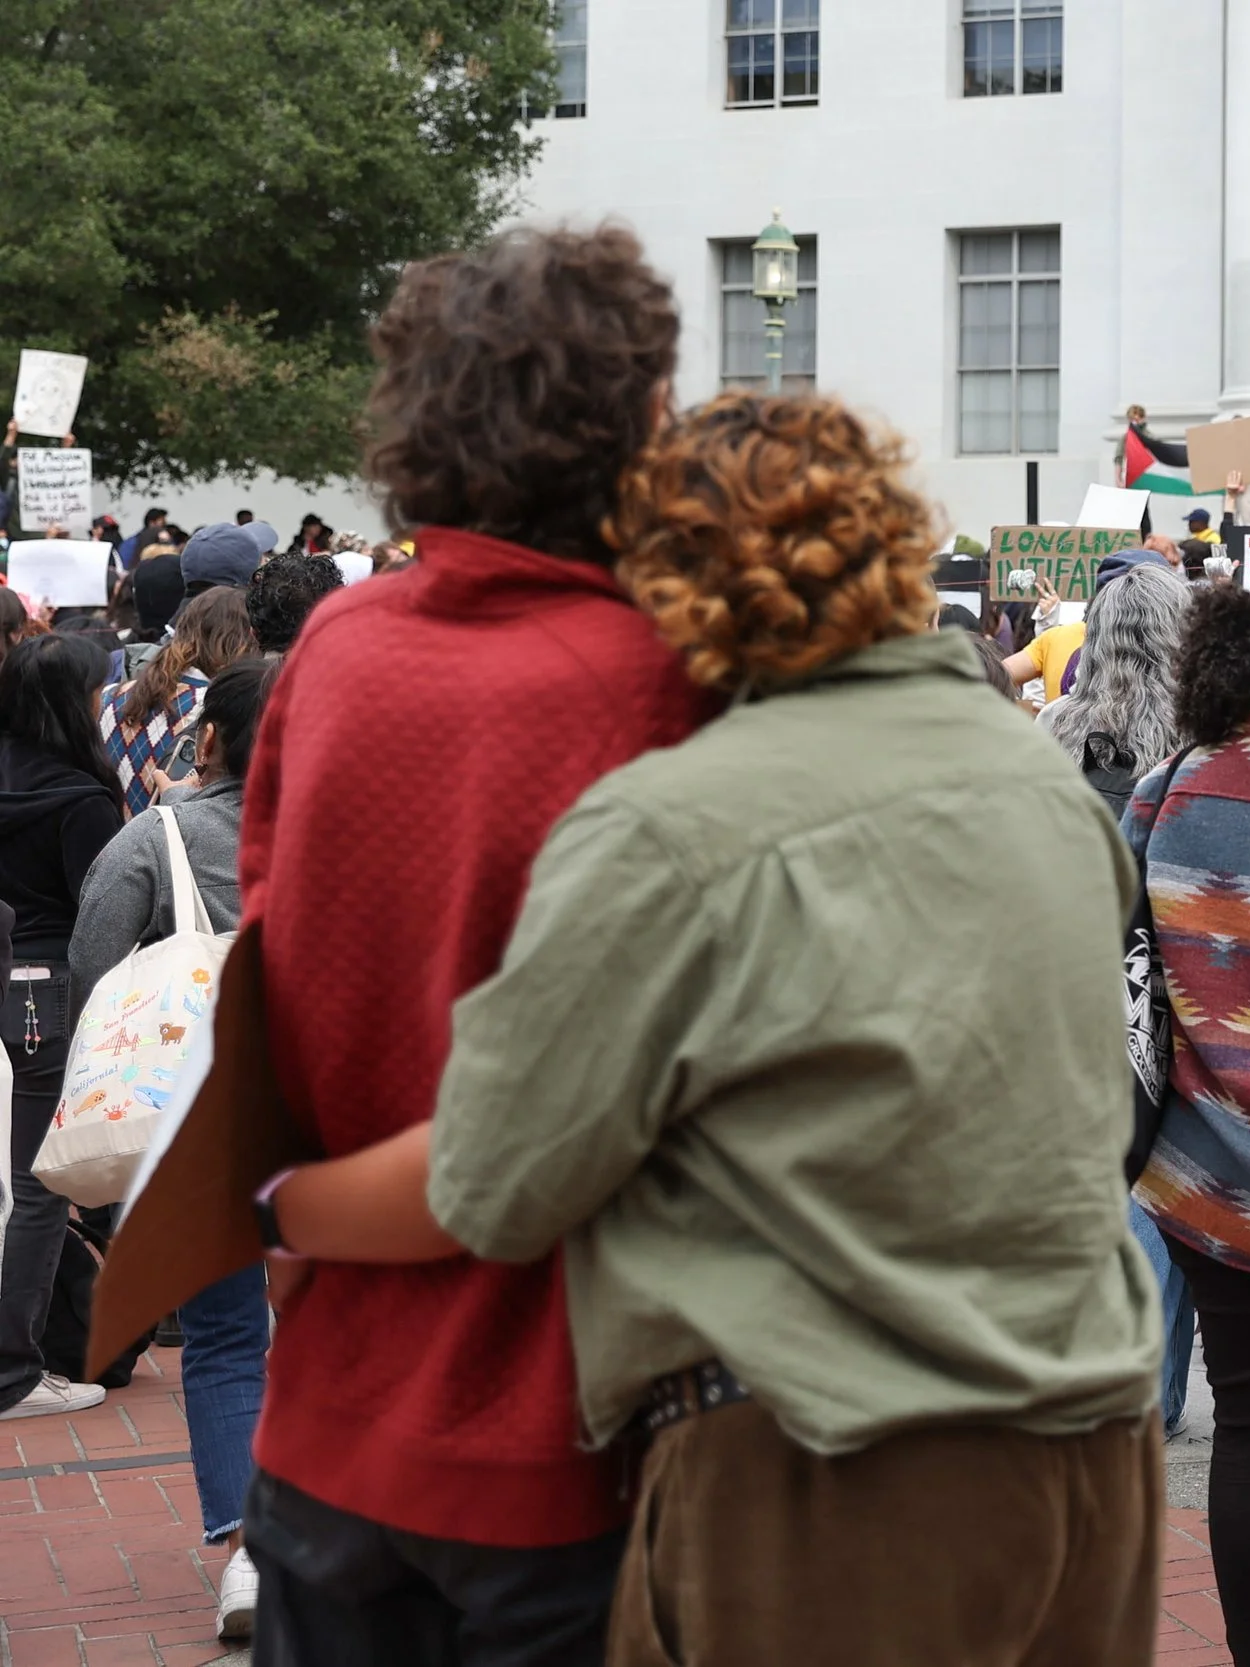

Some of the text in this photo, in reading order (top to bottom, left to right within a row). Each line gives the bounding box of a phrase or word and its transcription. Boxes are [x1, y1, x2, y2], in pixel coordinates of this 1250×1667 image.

[1000, 529, 1136, 555] LONG LIVE
[996, 557, 1102, 600] INTIFAD
